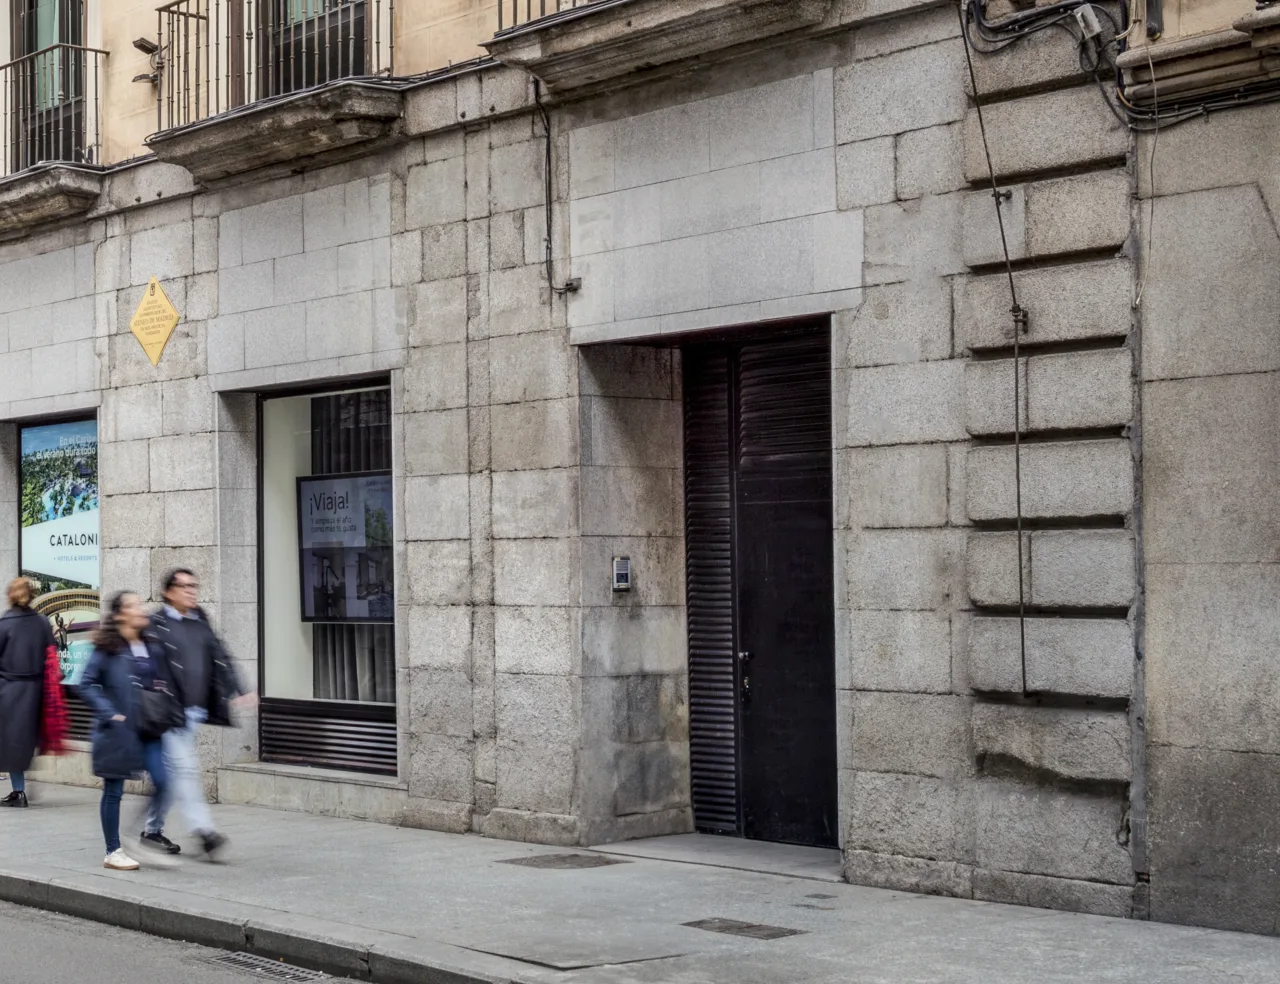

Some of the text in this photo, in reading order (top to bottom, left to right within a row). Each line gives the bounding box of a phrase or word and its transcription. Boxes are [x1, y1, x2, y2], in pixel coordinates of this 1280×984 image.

[60, 436, 68, 446] En
[69, 436, 75, 444] el
[65, 446, 80, 456] dura
[80, 446, 96, 455] todo
[310, 491, 349, 515] ¡Viaja!
[50, 533, 98, 546] CATALONI
